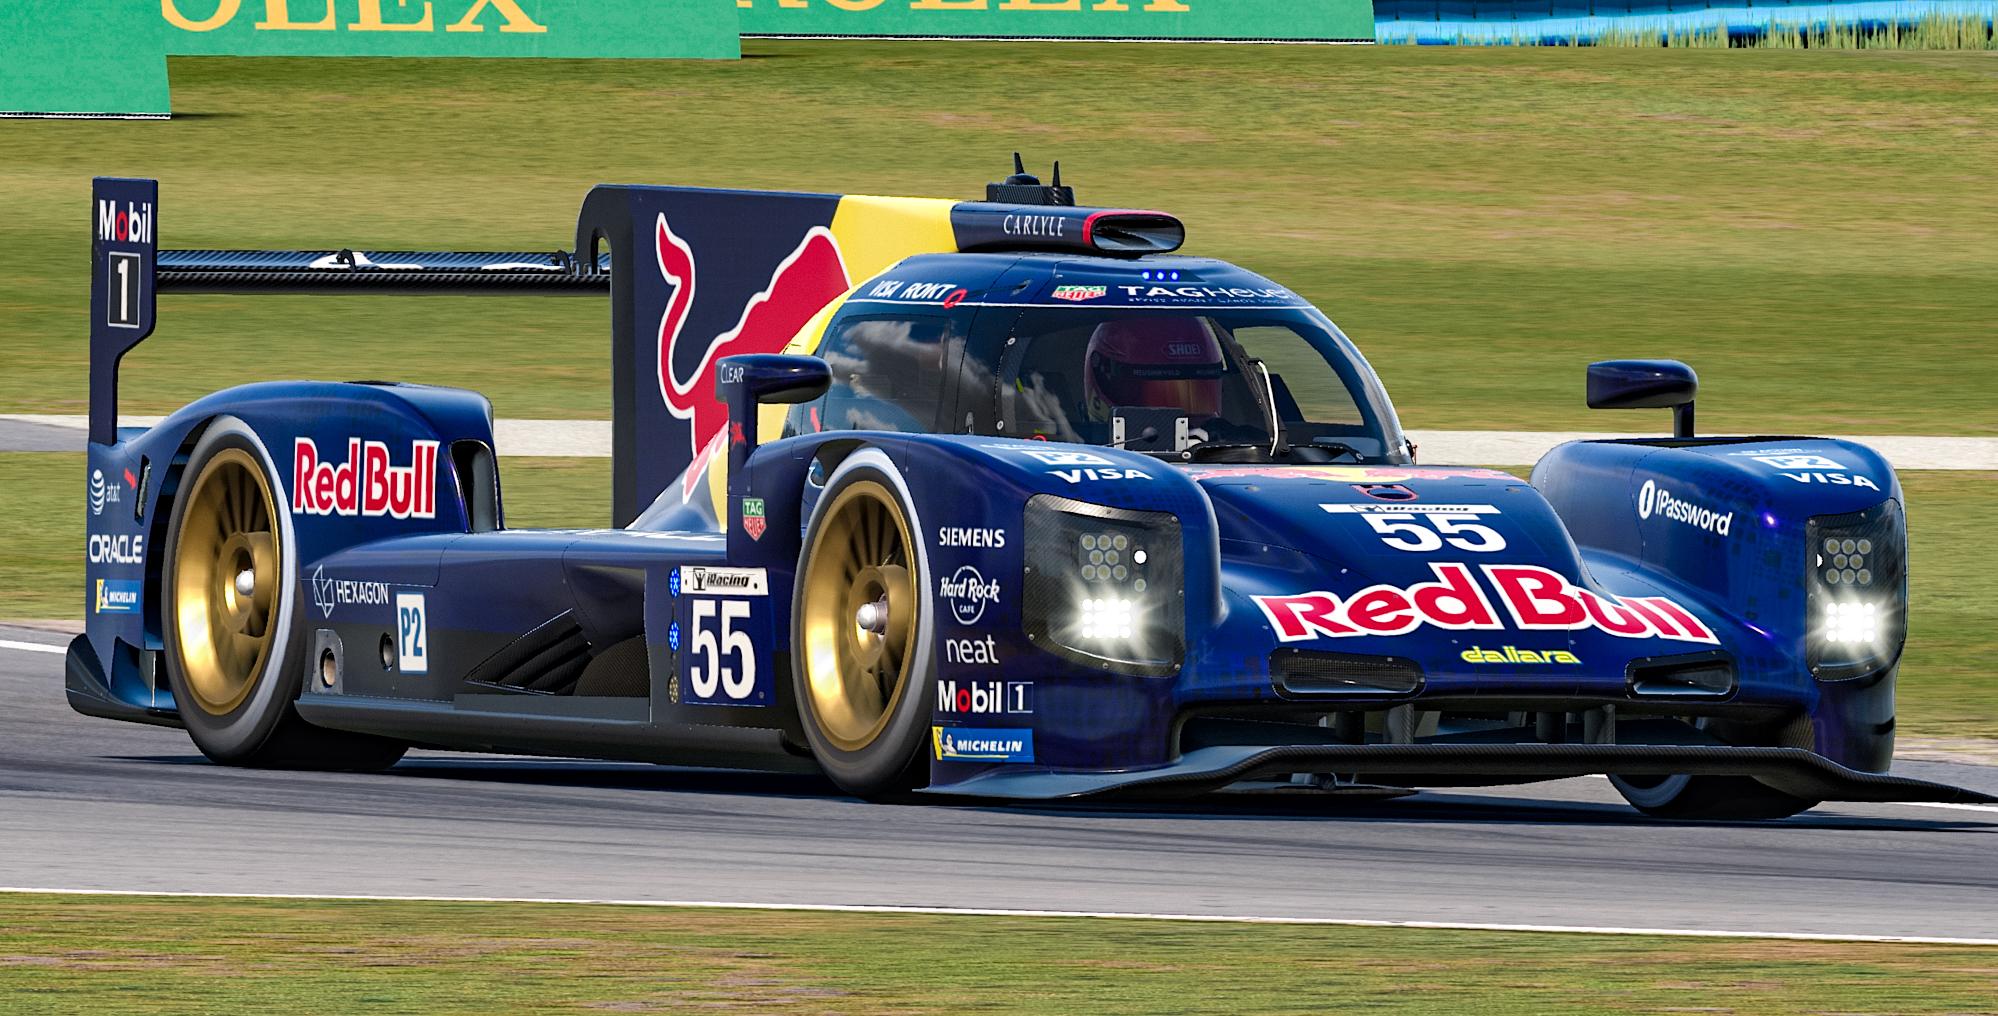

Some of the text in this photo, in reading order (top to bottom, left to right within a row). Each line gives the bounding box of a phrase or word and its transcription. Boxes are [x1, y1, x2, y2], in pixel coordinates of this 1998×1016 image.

[99, 200, 152, 244] Mobil
[1003, 214, 1066, 237] CARLYLE
[118, 258, 129, 322] 1
[869, 281, 957, 299] VISA ROKT
[294, 437, 440, 519] Red Bull
[1045, 469, 1153, 484] VISA
[1778, 473, 1881, 492] VISA
[106, 482, 121, 503] at&t
[744, 502, 763, 516] TAG
[1655, 488, 1733, 537] 1Password
[744, 516, 766, 538] HEUER
[939, 527, 1005, 548] SIEMENS
[1361, 513, 1507, 552] 55
[89, 534, 143, 564] ORACLE
[335, 580, 389, 605] HEXAGON
[707, 572, 750, 588] iRacing
[940, 577, 1000, 603] Hard Rock
[959, 605, 975, 614] CAFE
[1249, 562, 1720, 645] Red Bull
[401, 607, 423, 657] P2
[691, 600, 756, 699] 55
[946, 634, 999, 664] neat
[1461, 646, 1582, 664] dallara
[938, 680, 1024, 714] Mobil 1
[957, 740, 1023, 752] MICHELIN
